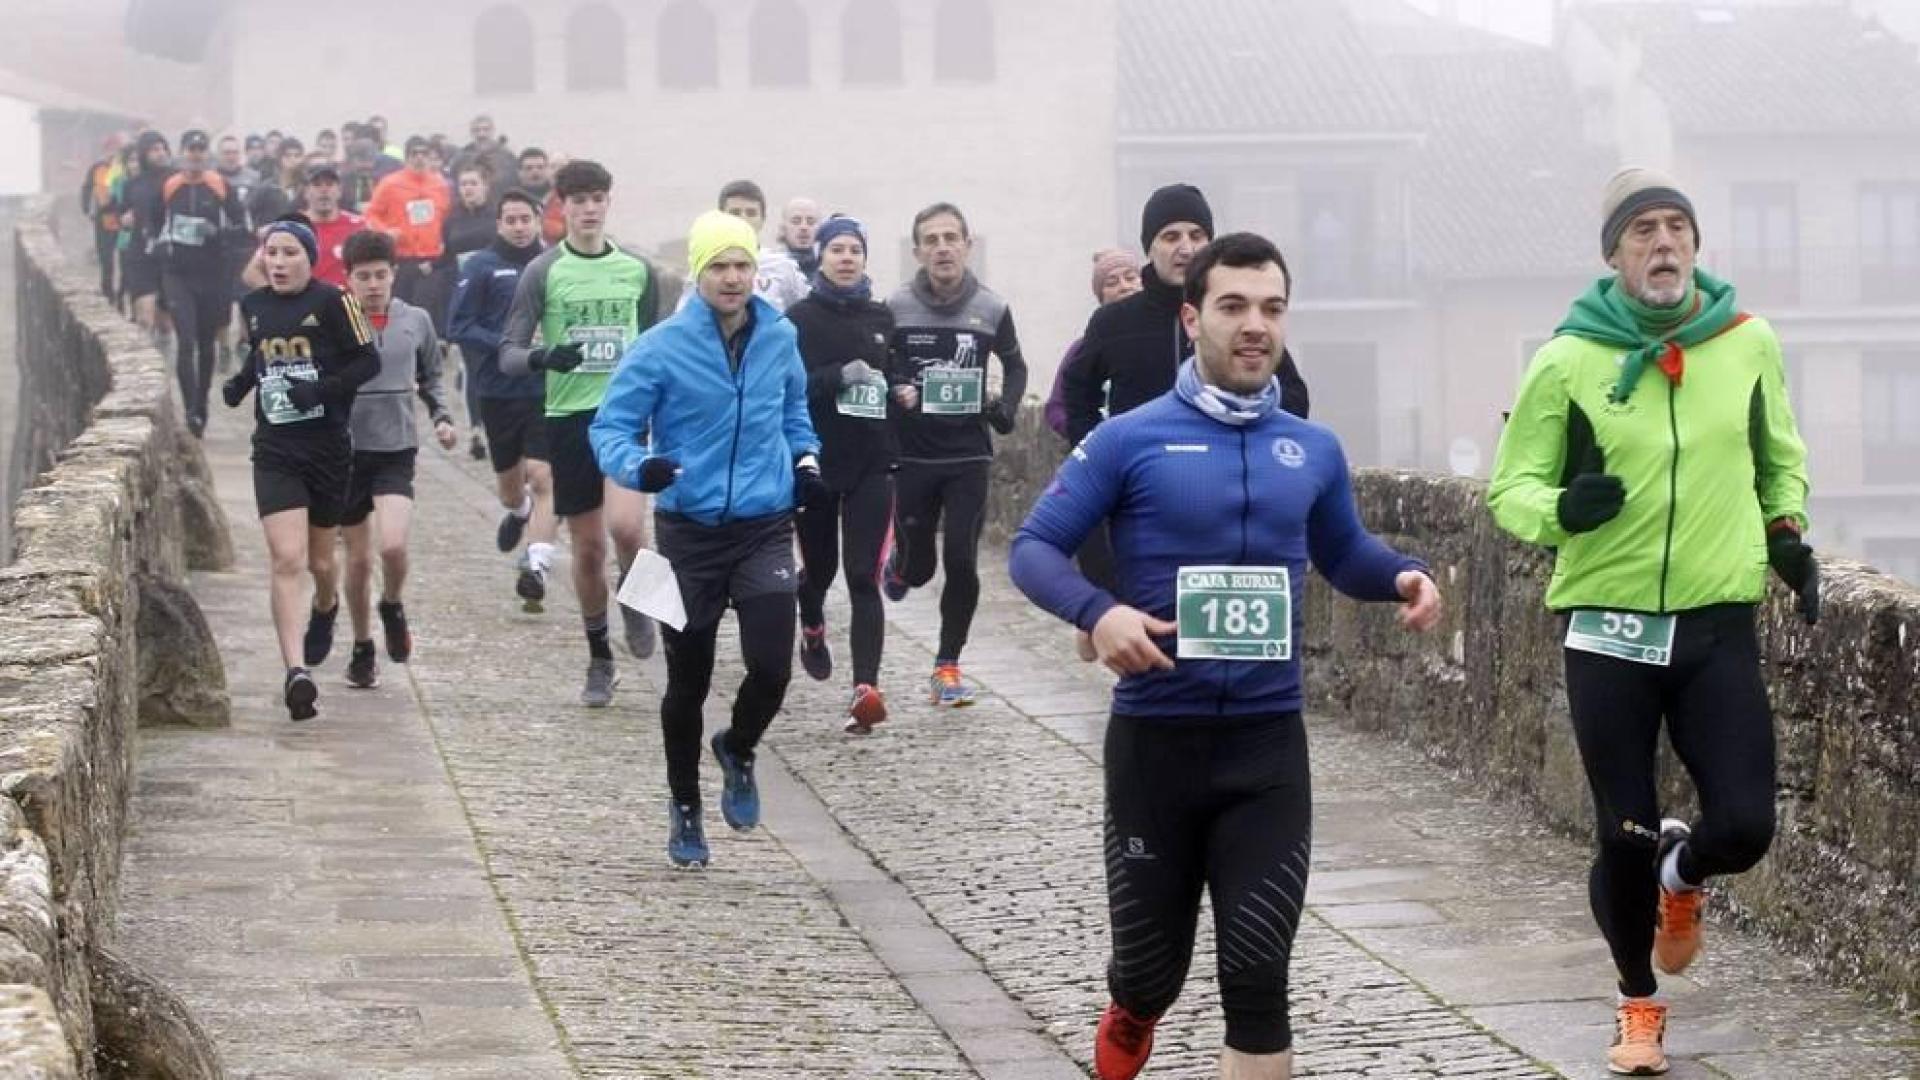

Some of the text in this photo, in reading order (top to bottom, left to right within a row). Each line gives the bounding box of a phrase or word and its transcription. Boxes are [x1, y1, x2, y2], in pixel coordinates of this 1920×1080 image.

[580, 342, 616, 360] 140
[849, 384, 879, 404] 178
[940, 384, 963, 402] 61
[1231, 574, 1281, 589] RURAL
[1200, 598, 1270, 635] 183
[1601, 611, 1644, 639] 55
